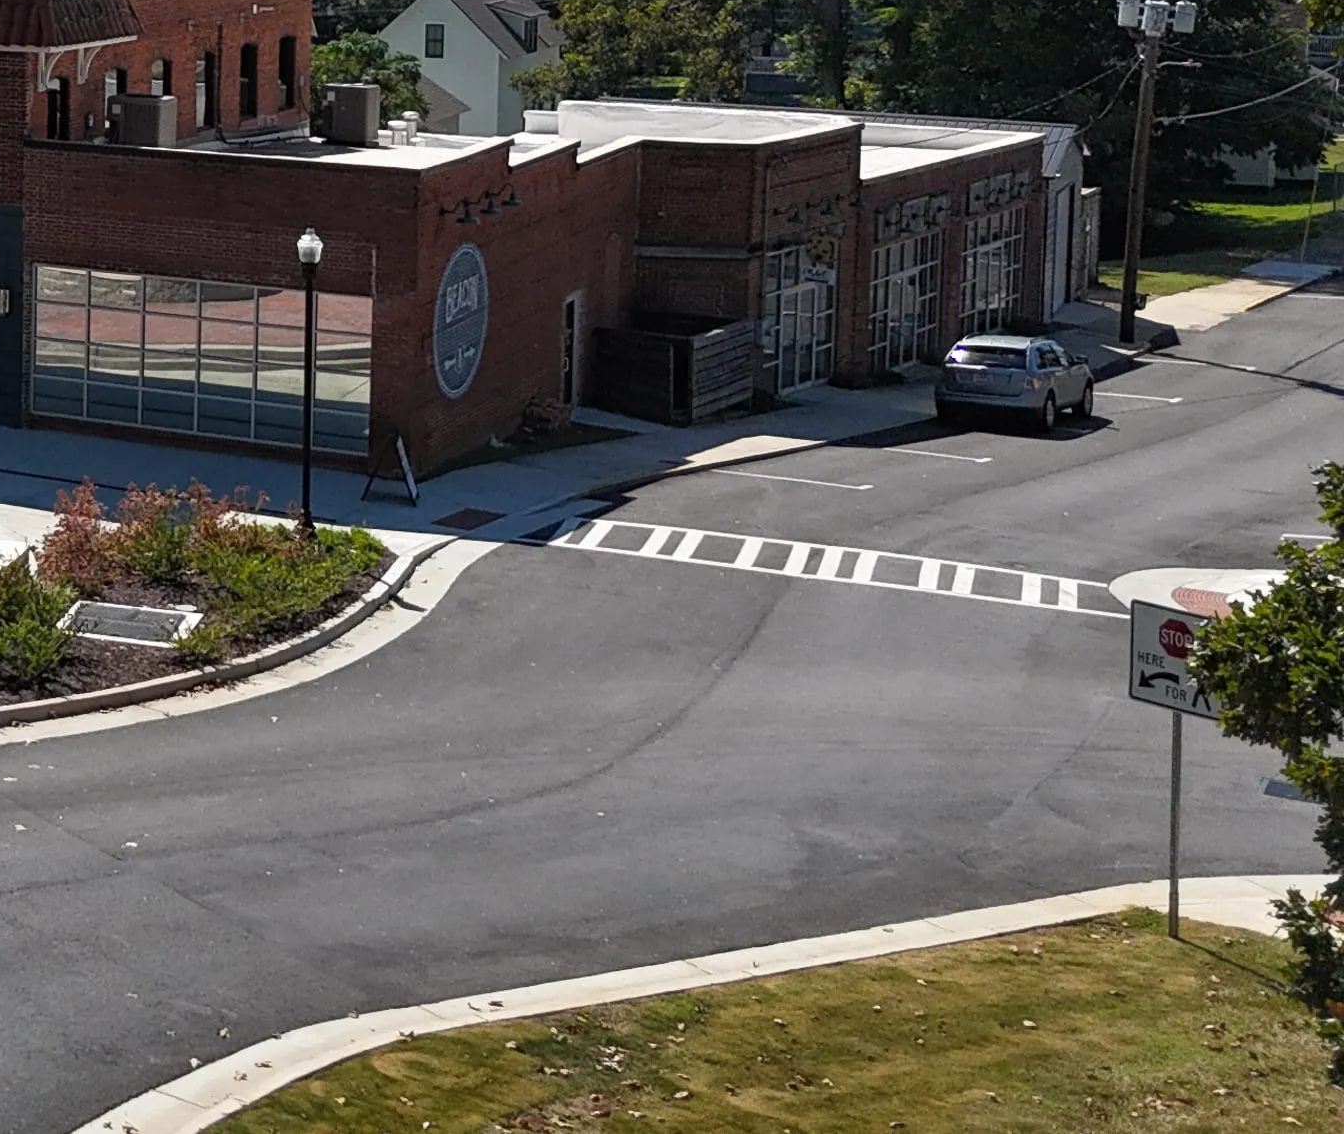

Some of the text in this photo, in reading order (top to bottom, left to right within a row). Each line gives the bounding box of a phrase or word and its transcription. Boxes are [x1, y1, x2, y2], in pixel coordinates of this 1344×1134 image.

[445, 273, 480, 324] BEACON
[1160, 628, 1193, 647] STOP
[1137, 650, 1165, 669] HERE
[1165, 684, 1187, 702] FOR
